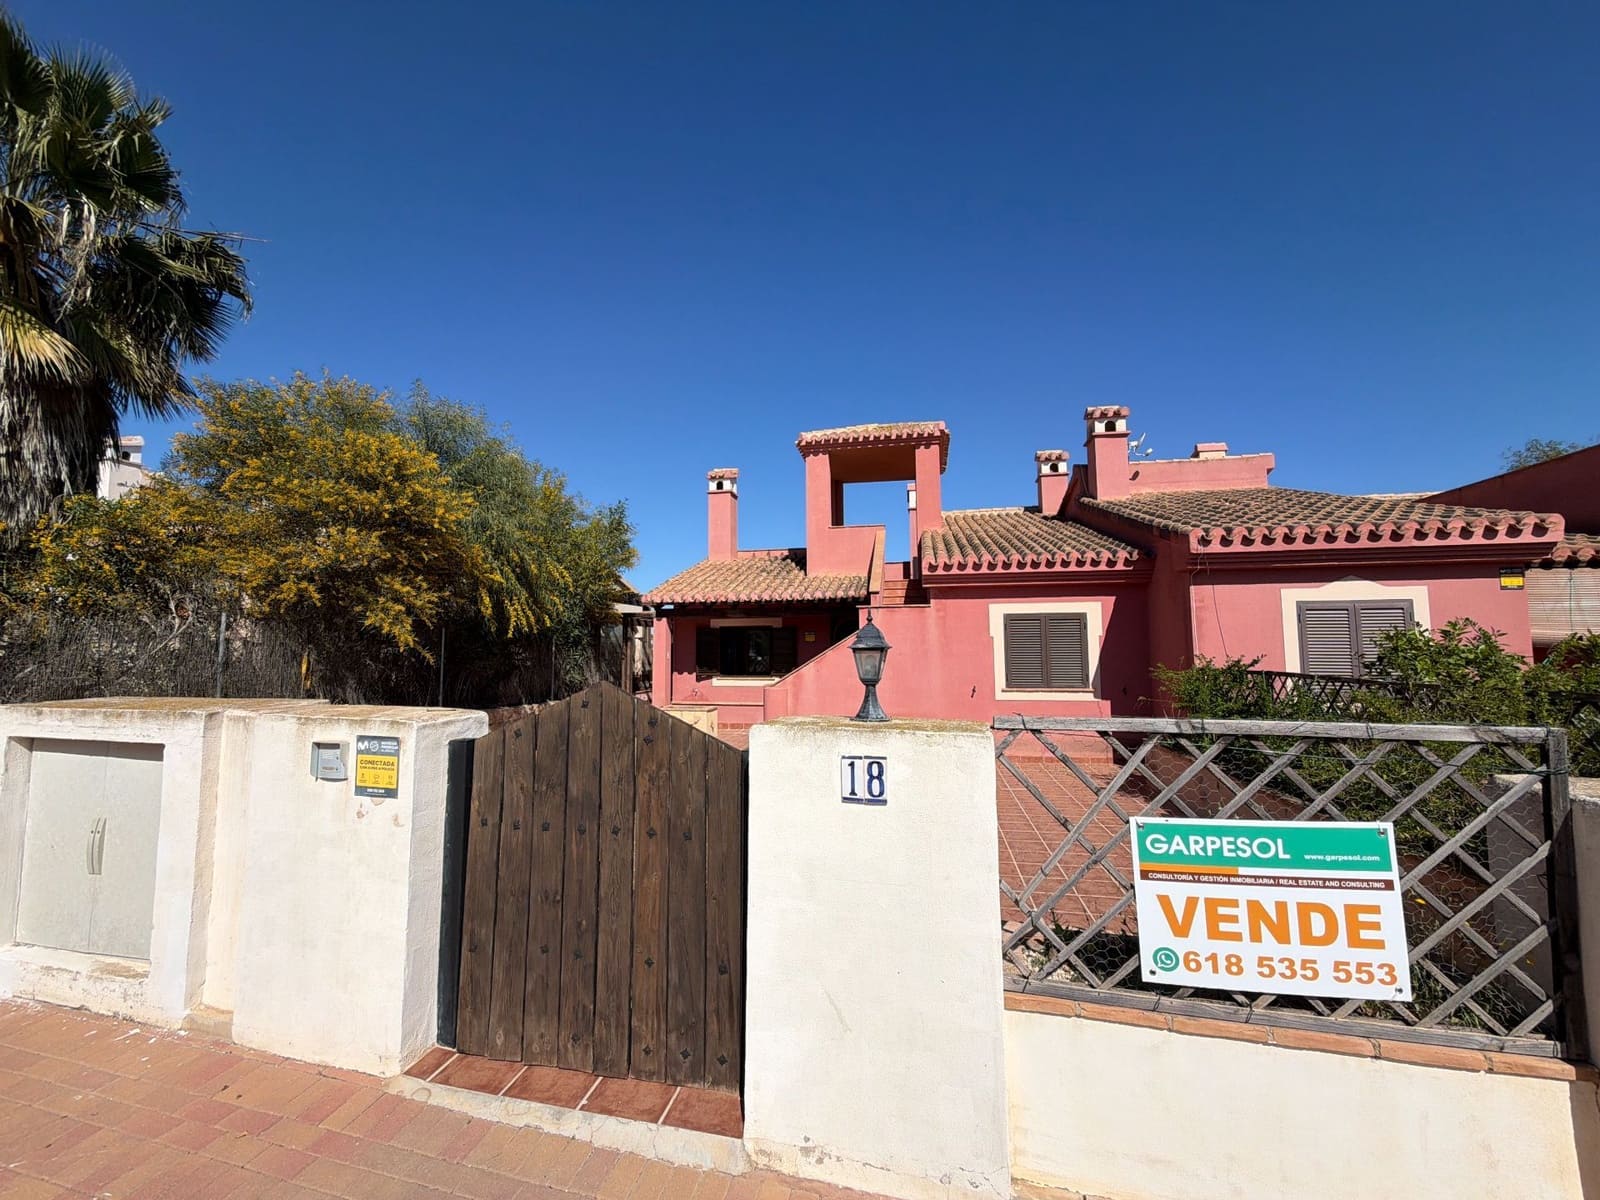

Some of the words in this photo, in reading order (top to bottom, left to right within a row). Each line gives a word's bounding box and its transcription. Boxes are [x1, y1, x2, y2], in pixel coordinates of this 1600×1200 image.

[847, 760, 885, 798] 18
[1145, 833, 1291, 860] GARPESOL
[1303, 854, 1381, 862] www.garpesol.com
[1148, 872, 1194, 881] CONSULTORÍA
[1199, 875, 1229, 883] GESTIÓN
[1229, 877, 1275, 885] INMOBILIARIA
[1156, 893, 1386, 950] VENDE
[1182, 950, 1244, 976] 618
[1256, 955, 1320, 981] 535
[1332, 961, 1398, 986] 553
